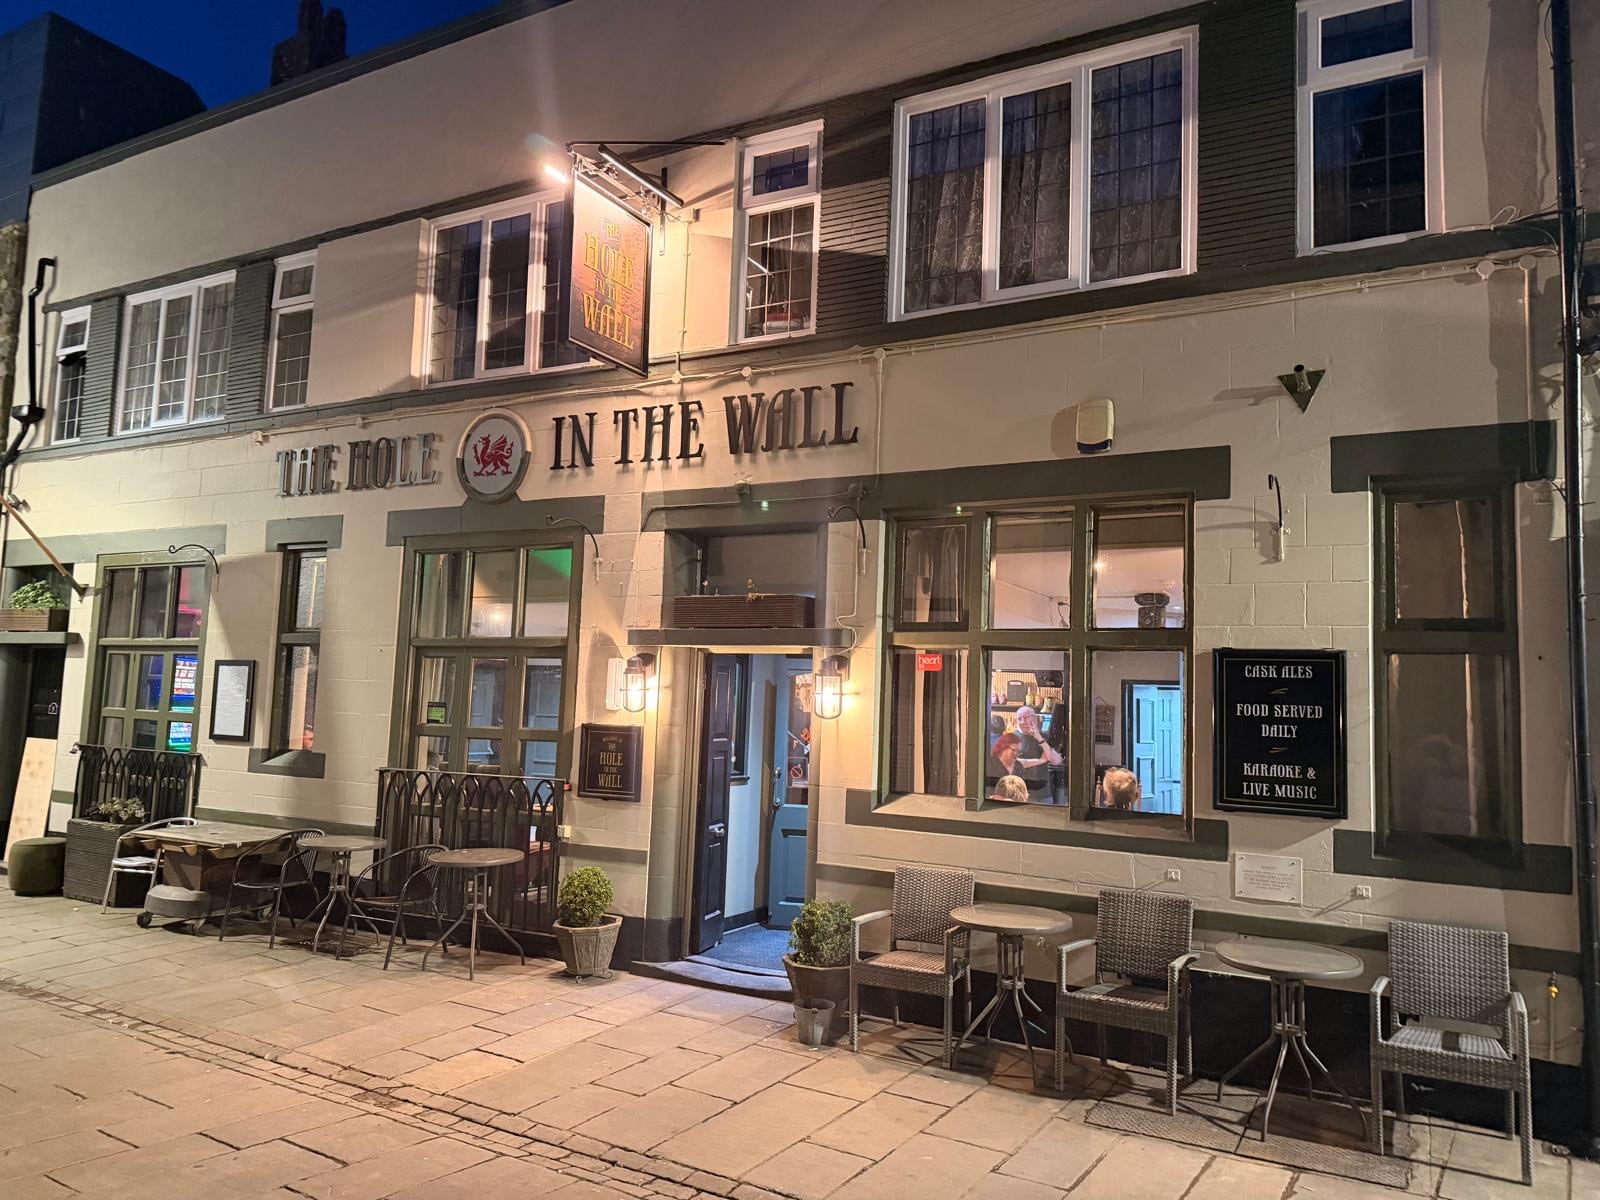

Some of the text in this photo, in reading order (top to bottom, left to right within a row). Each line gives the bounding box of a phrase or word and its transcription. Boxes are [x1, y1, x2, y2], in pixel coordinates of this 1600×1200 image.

[584, 231, 634, 291] HOLE
[583, 292, 634, 350] WALL
[275, 382, 859, 497] THE HOLE IN THE WALL
[918, 655, 942, 665] heart
[1244, 664, 1313, 679] CASK ALES
[1236, 703, 1323, 719] FOOD SERVED
[1261, 724, 1299, 738] DAILY
[600, 752, 623, 766] HOLE
[1243, 762, 1317, 780] KARAOKE &
[598, 774, 622, 788] WALL
[1242, 782, 1318, 800] LIVE MUSIC
